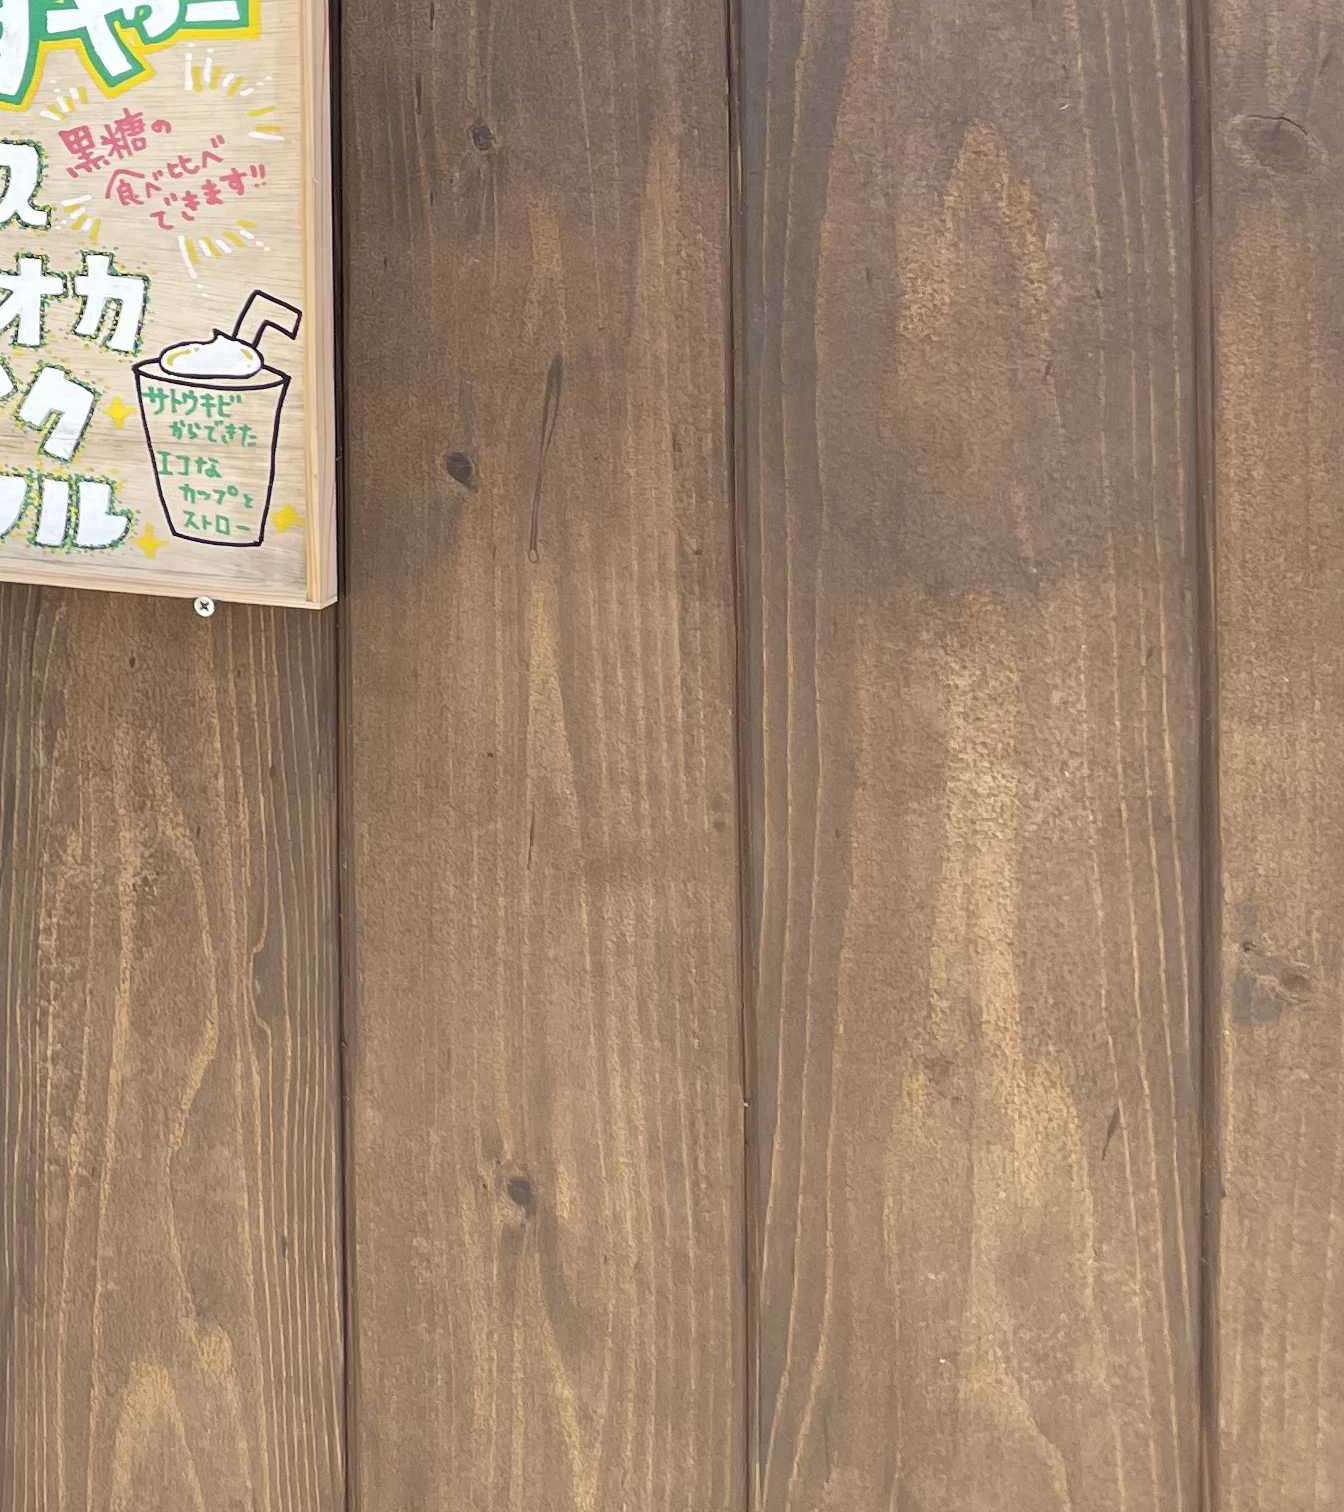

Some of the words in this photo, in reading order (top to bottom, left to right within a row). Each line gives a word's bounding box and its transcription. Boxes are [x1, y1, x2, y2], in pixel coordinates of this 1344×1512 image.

[58, 108, 172, 179] 黒糖の
[105, 136, 226, 206] 食べ比べ
[142, 387, 245, 419] サトウキビ
[170, 418, 258, 449] からできた
[158, 450, 221, 480] エコな
[179, 484, 254, 508] カップと
[183, 510, 252, 535] ストロー
